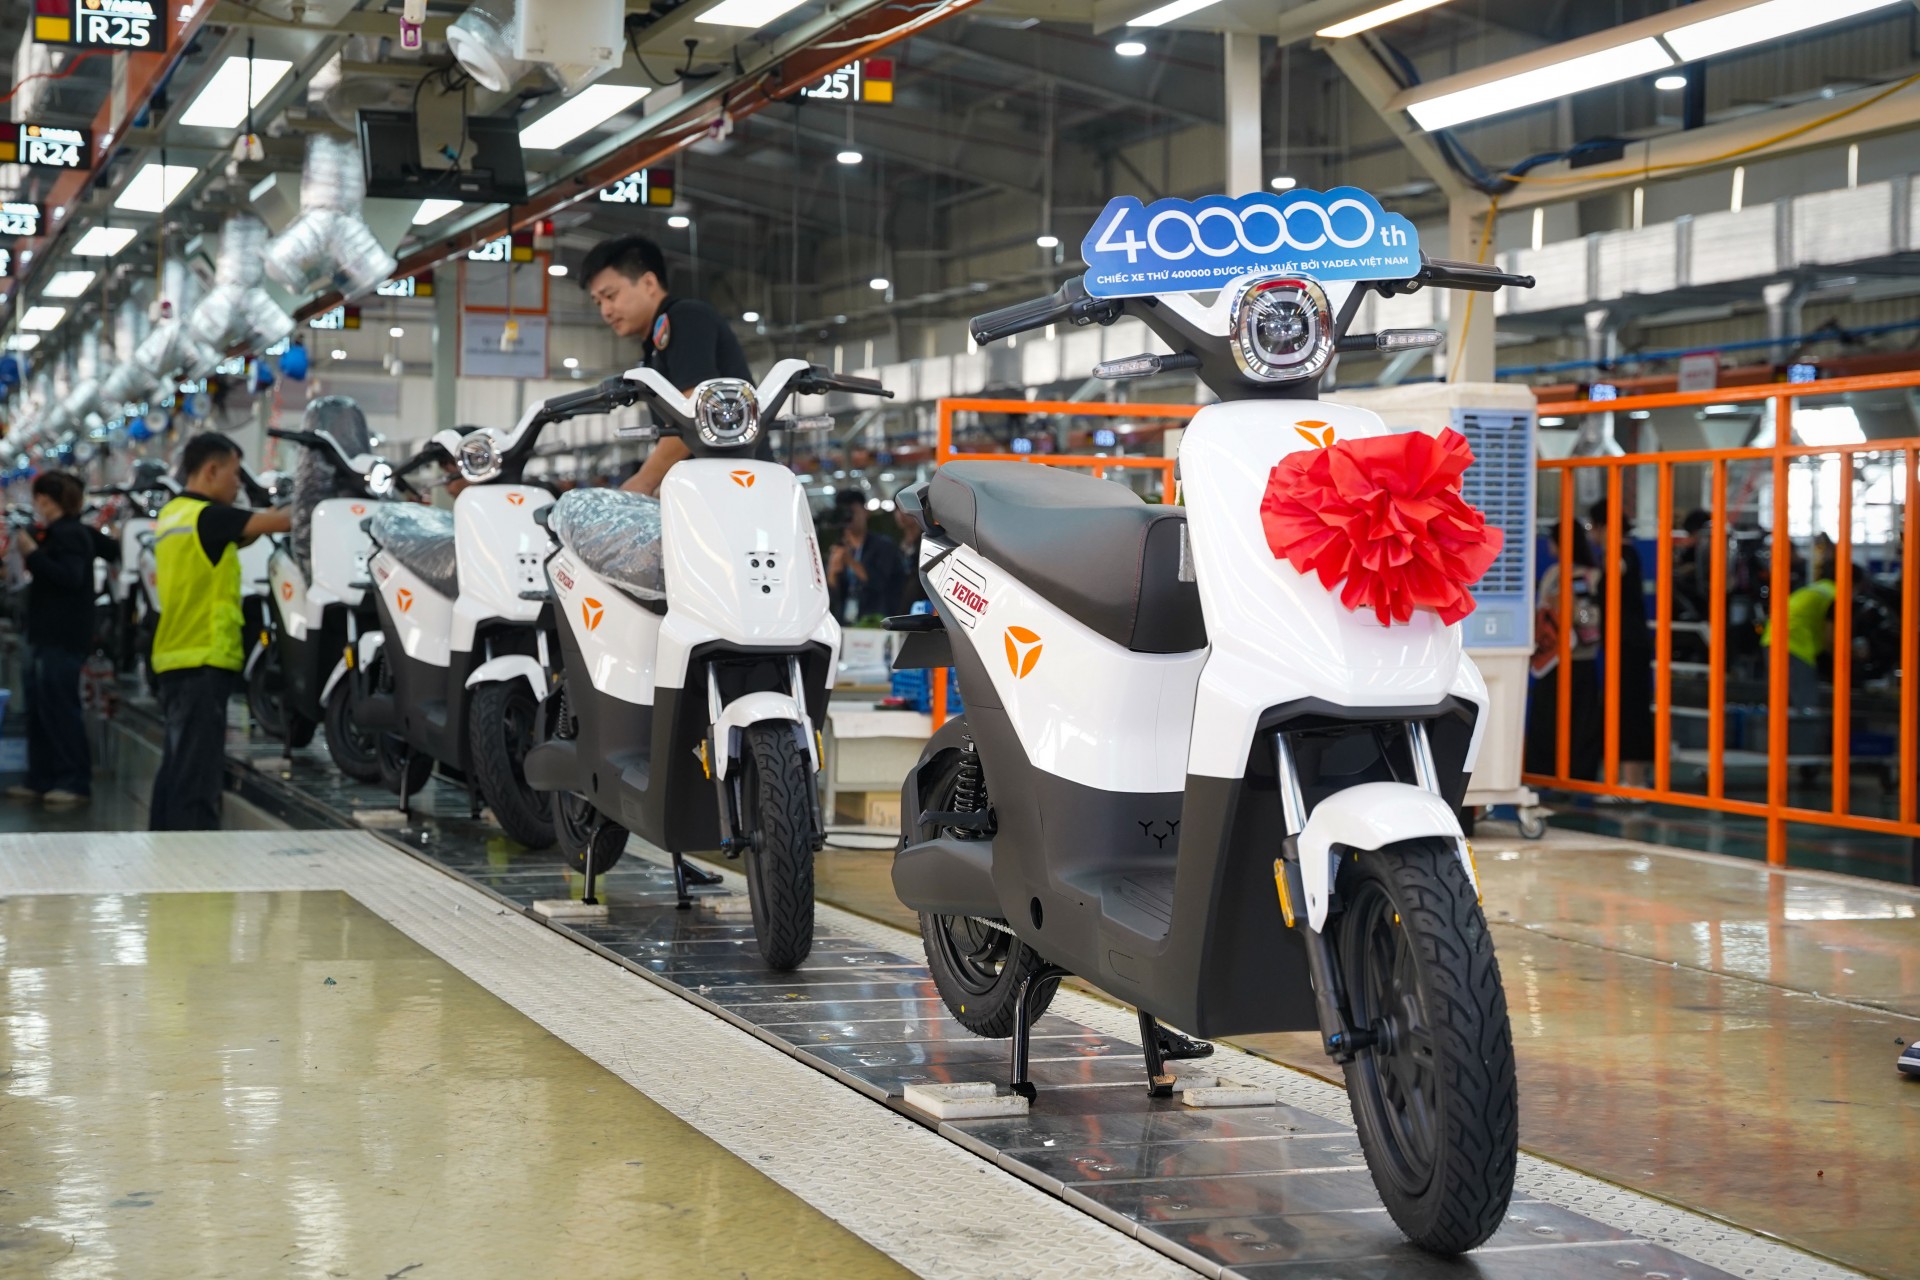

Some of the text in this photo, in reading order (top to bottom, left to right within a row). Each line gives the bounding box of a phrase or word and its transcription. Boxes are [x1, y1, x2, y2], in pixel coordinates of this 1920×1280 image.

[89, 15, 151, 47] R25
[29, 141, 80, 168] R24
[1096, 271, 1129, 284] CHIẾC
[1130, 273, 1145, 282] XE
[1146, 269, 1170, 281] THỨ
[1171, 268, 1211, 279] 400000
[1246, 262, 1268, 274] SẢN
[1271, 260, 1299, 272] XUẤT
[1301, 258, 1320, 270] BỞI
[1321, 258, 1356, 269] YADEA
[1357, 256, 1382, 268] VIỆT
[1384, 256, 1409, 265] NAM
